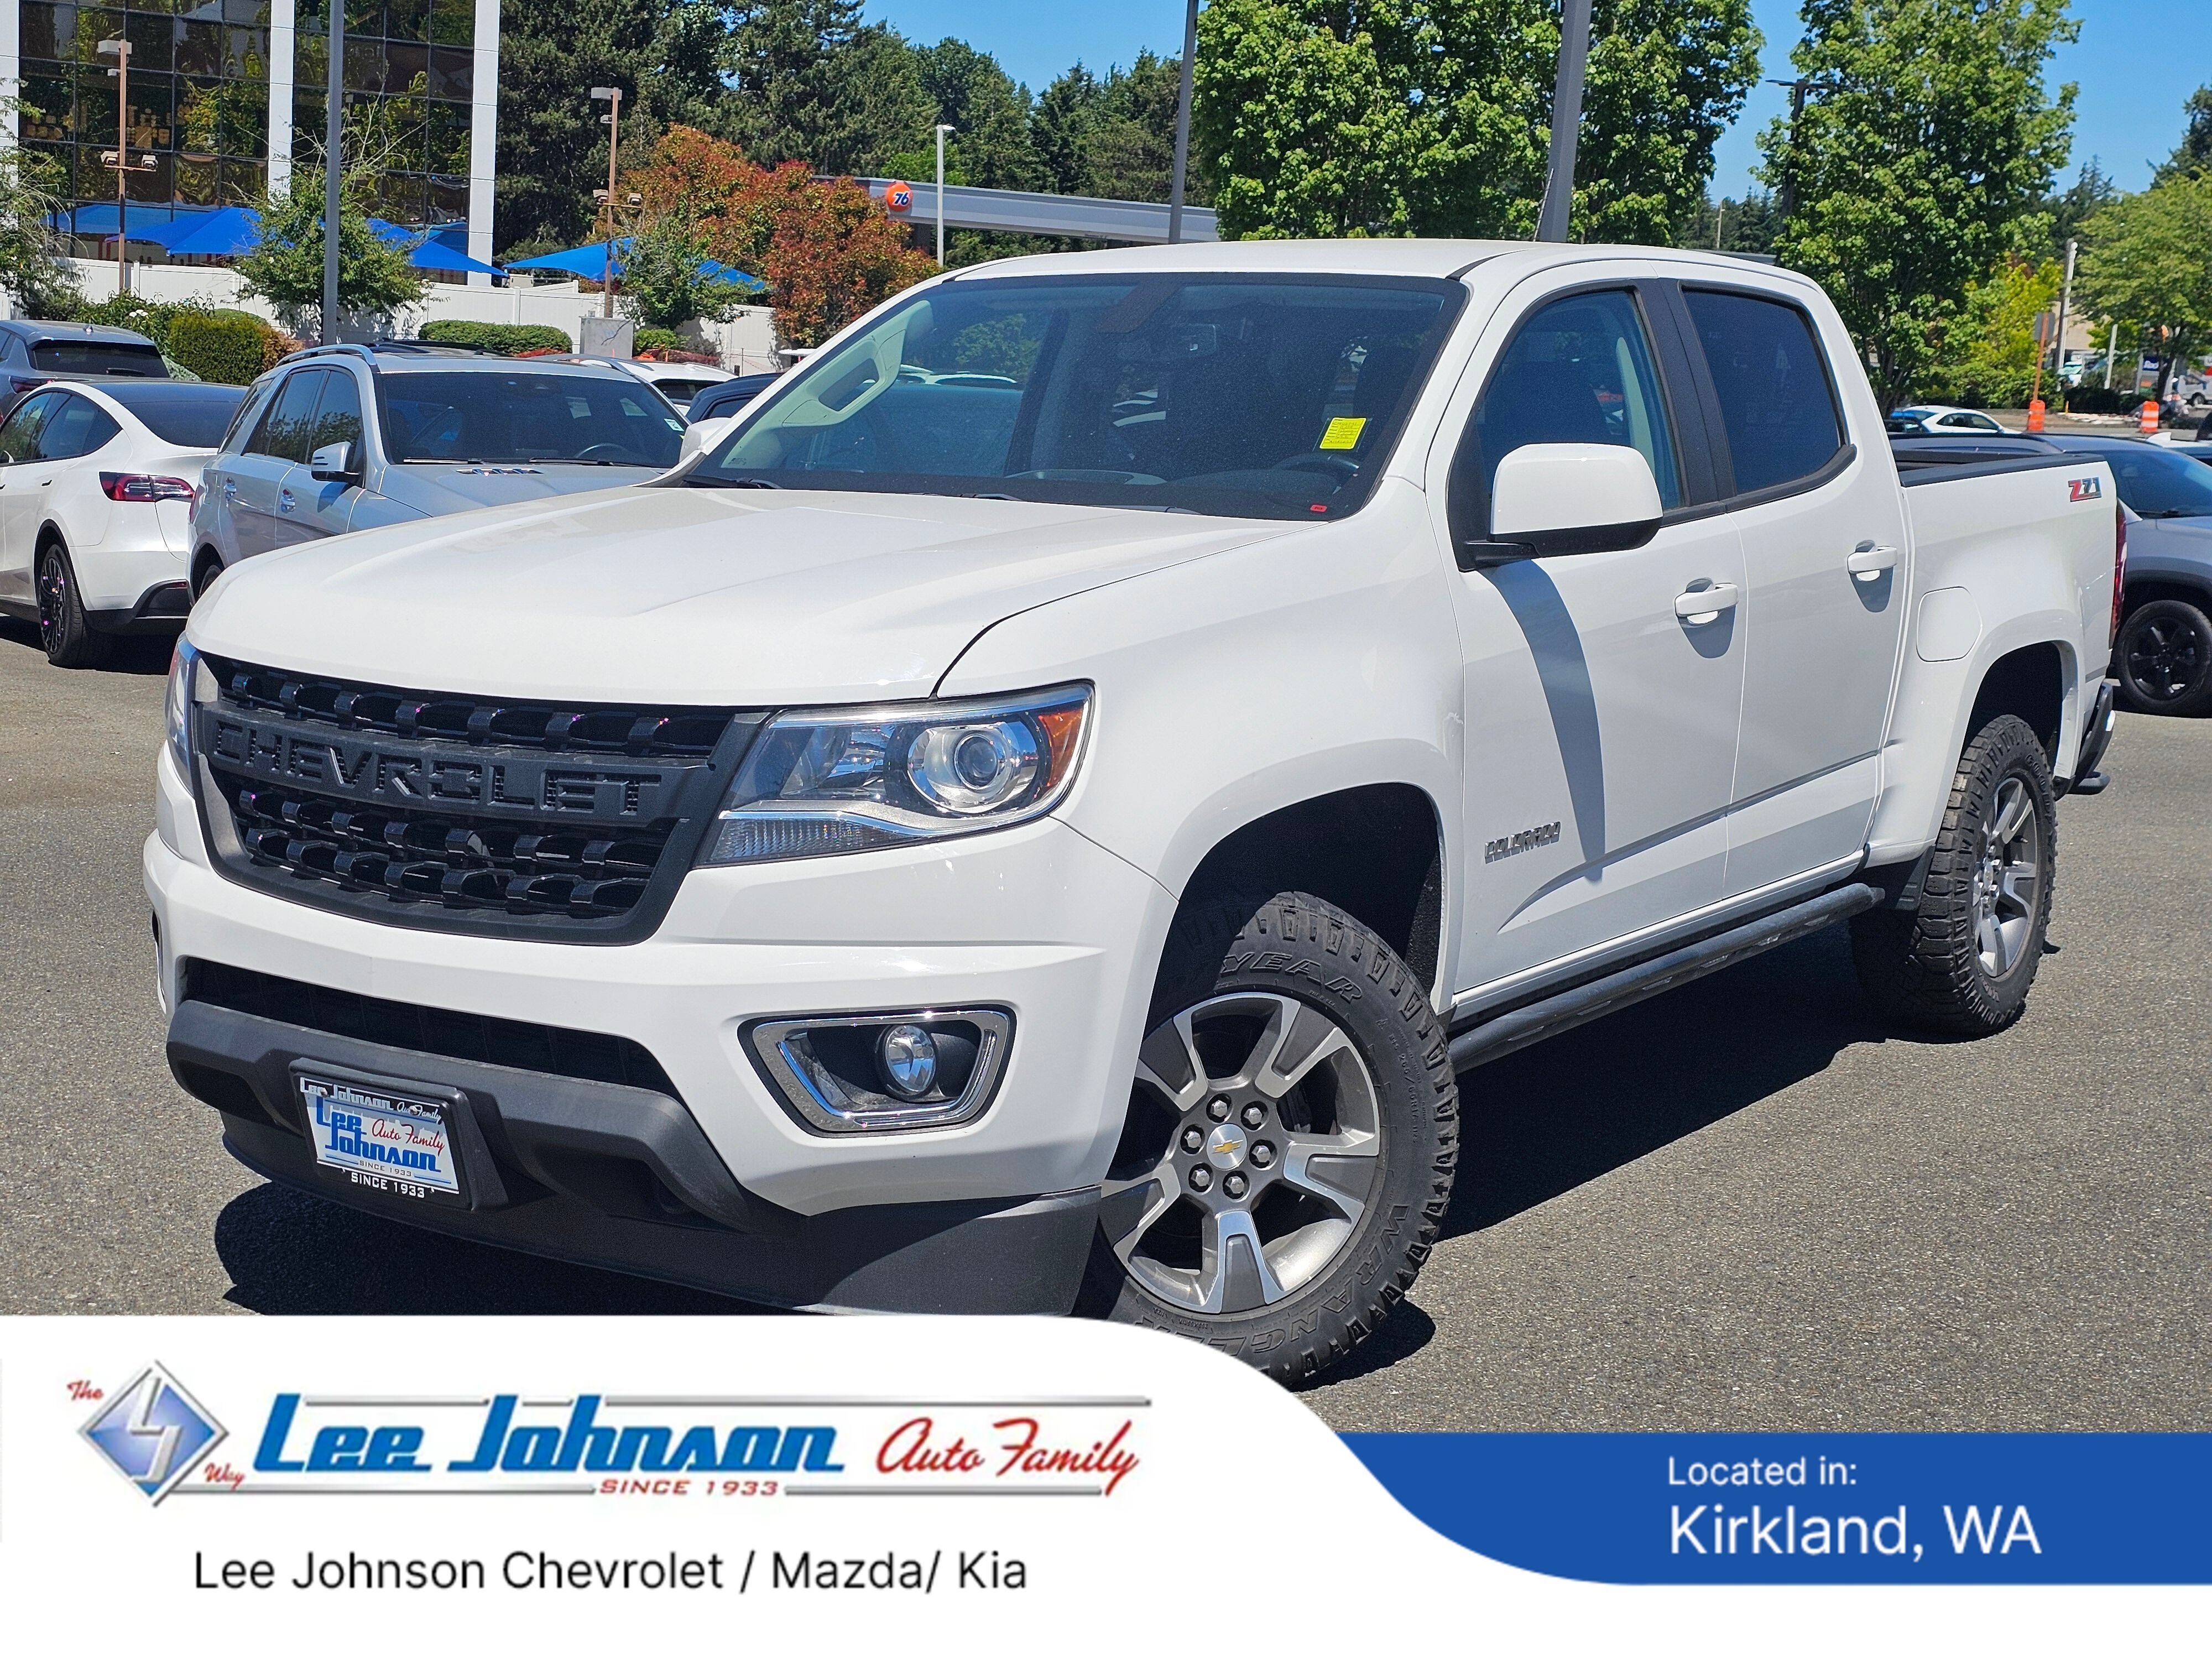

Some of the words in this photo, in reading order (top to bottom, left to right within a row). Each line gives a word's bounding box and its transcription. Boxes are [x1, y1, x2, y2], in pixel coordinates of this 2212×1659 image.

[893, 191, 910, 206] 76
[2068, 477, 2102, 502] Z71
[214, 718, 662, 816] CHEVROLET
[316, 1095, 367, 1135] Lee
[330, 1084, 394, 1110] Johnson
[397, 1102, 417, 1114] Au
[414, 1104, 442, 1124] Family
[325, 1128, 442, 1173] Johnson
[372, 1118, 402, 1141] Auto
[400, 1123, 445, 1156] Family
[351, 1172, 388, 1190] SINCE
[394, 1182, 425, 1199] 1933
[359, 1160, 385, 1172] SINCE
[390, 1167, 412, 1177] 1933
[1134, 1204, 1410, 1357] WRANGL
